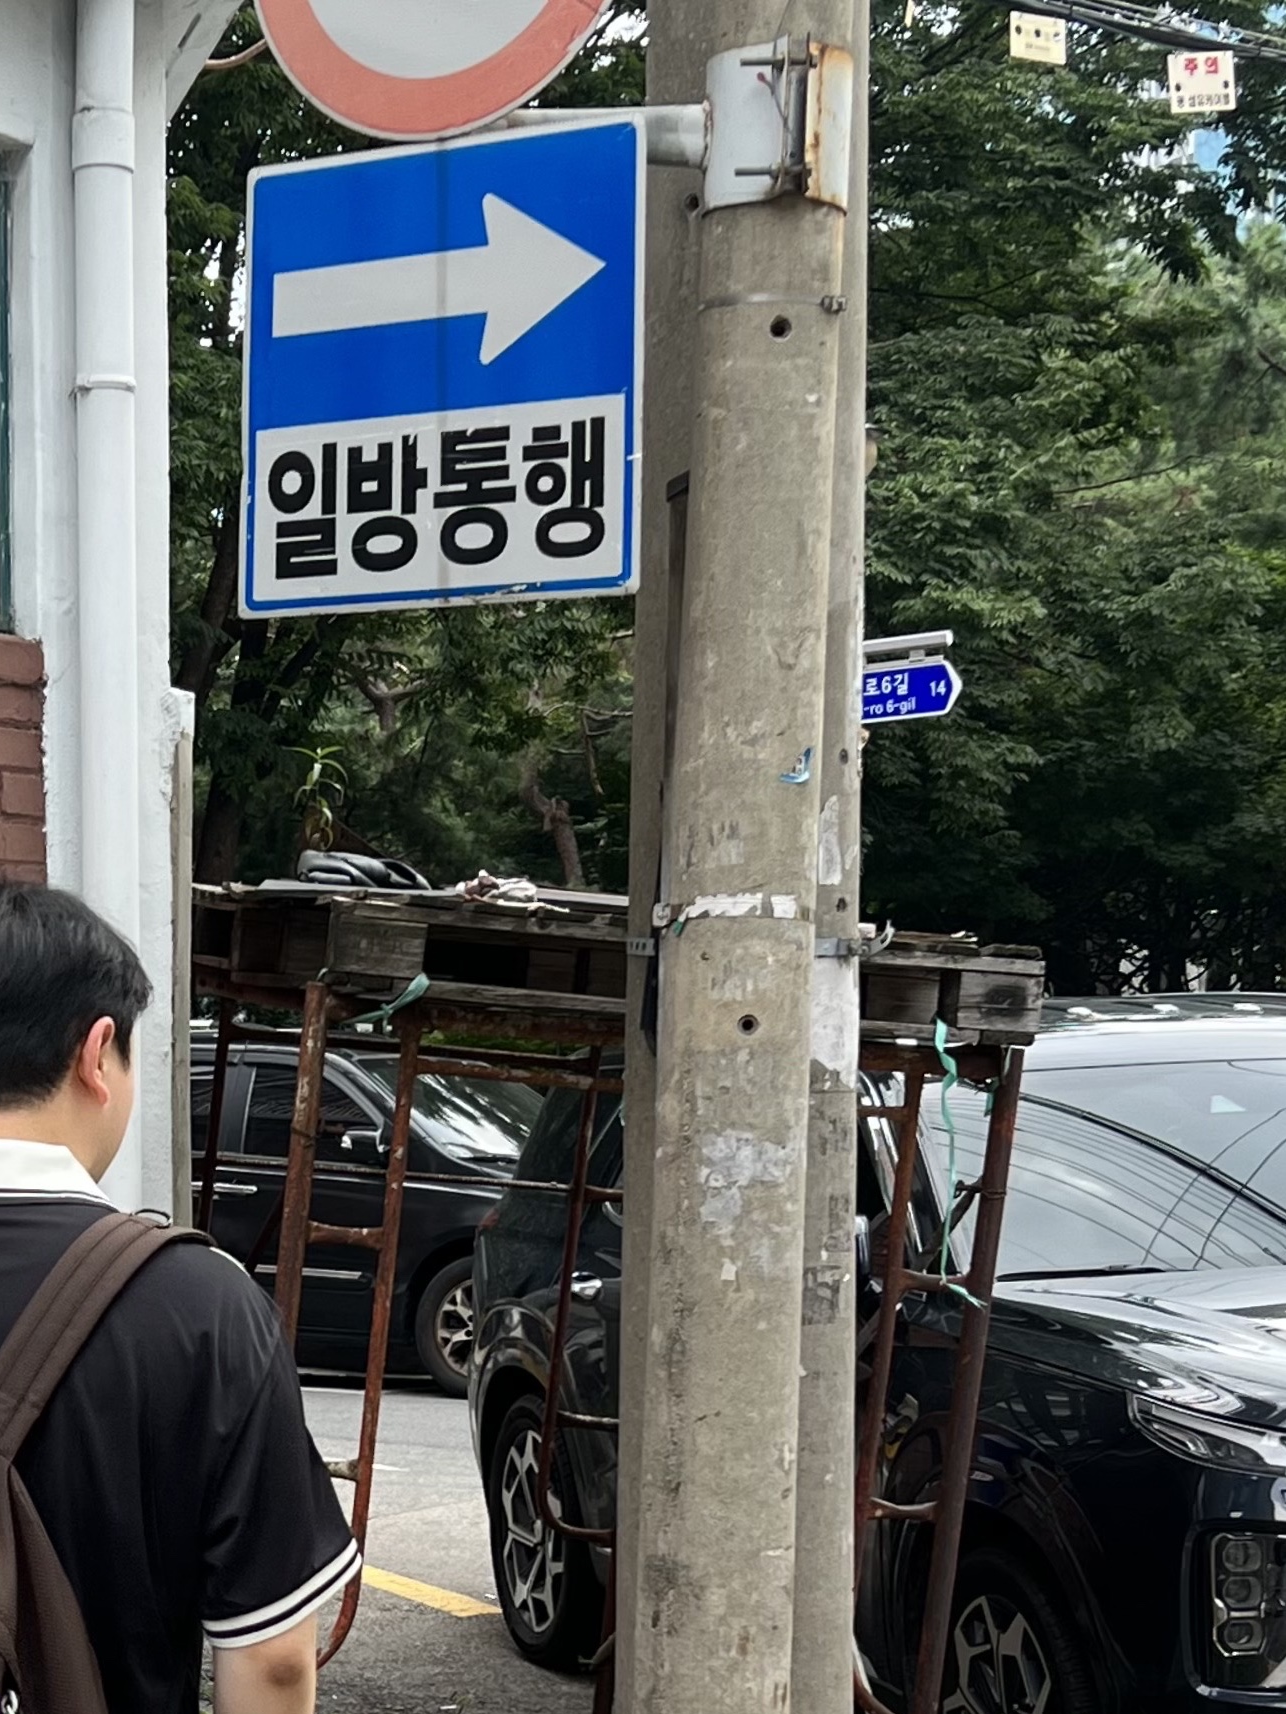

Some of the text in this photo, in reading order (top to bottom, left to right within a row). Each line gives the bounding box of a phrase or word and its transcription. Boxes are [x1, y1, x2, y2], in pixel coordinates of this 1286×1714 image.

[266, 415, 607, 580] 일방통행
[929, 679, 948, 697] 14
[886, 697, 916, 714] 6-gil
